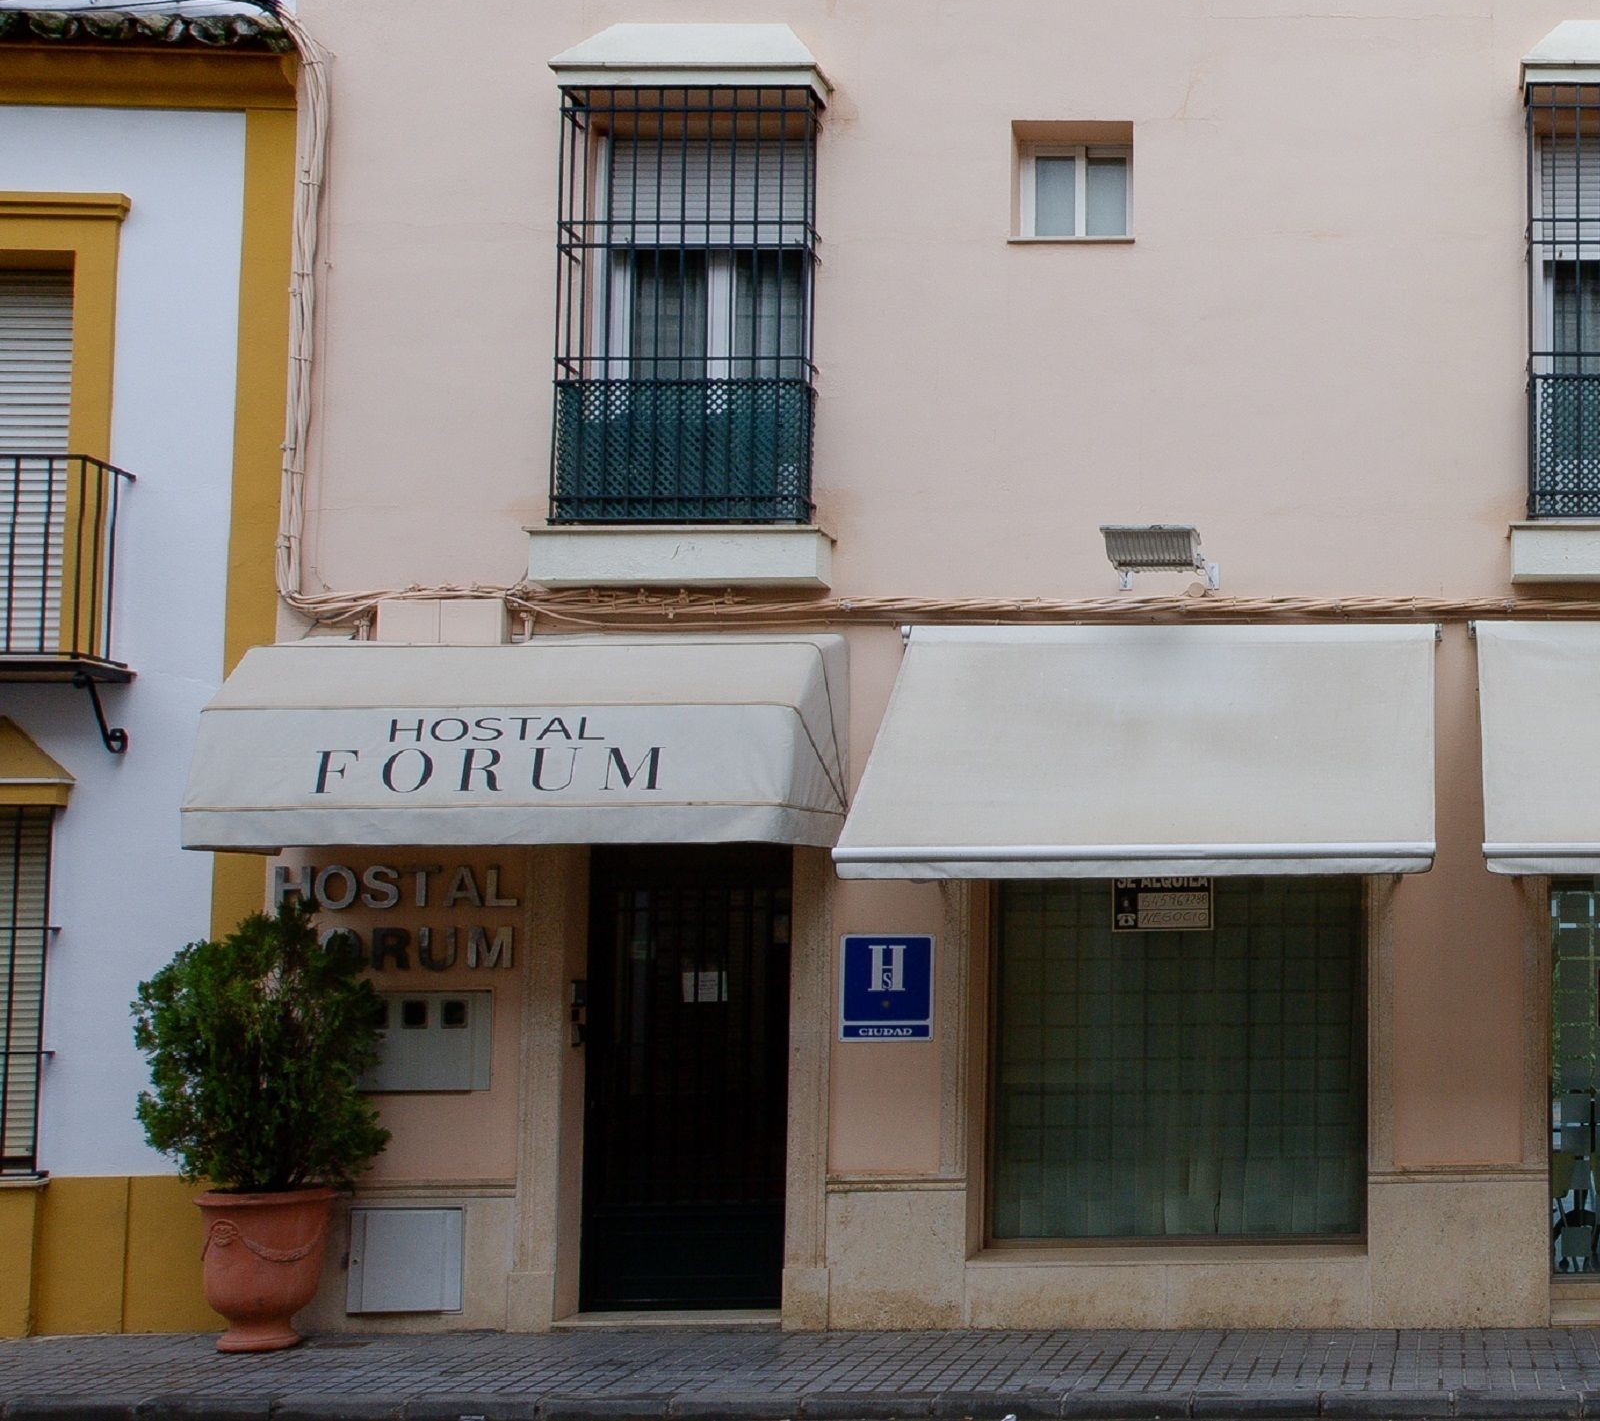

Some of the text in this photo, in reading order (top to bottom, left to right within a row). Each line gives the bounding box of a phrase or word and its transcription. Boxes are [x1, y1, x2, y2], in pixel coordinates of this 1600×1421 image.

[389, 716, 605, 743] HOSTAL
[308, 745, 666, 794] FORUM
[275, 865, 519, 910] HOSTAL
[318, 926, 514, 970] ORUM
[858, 1027, 912, 1036] CIUDAD
